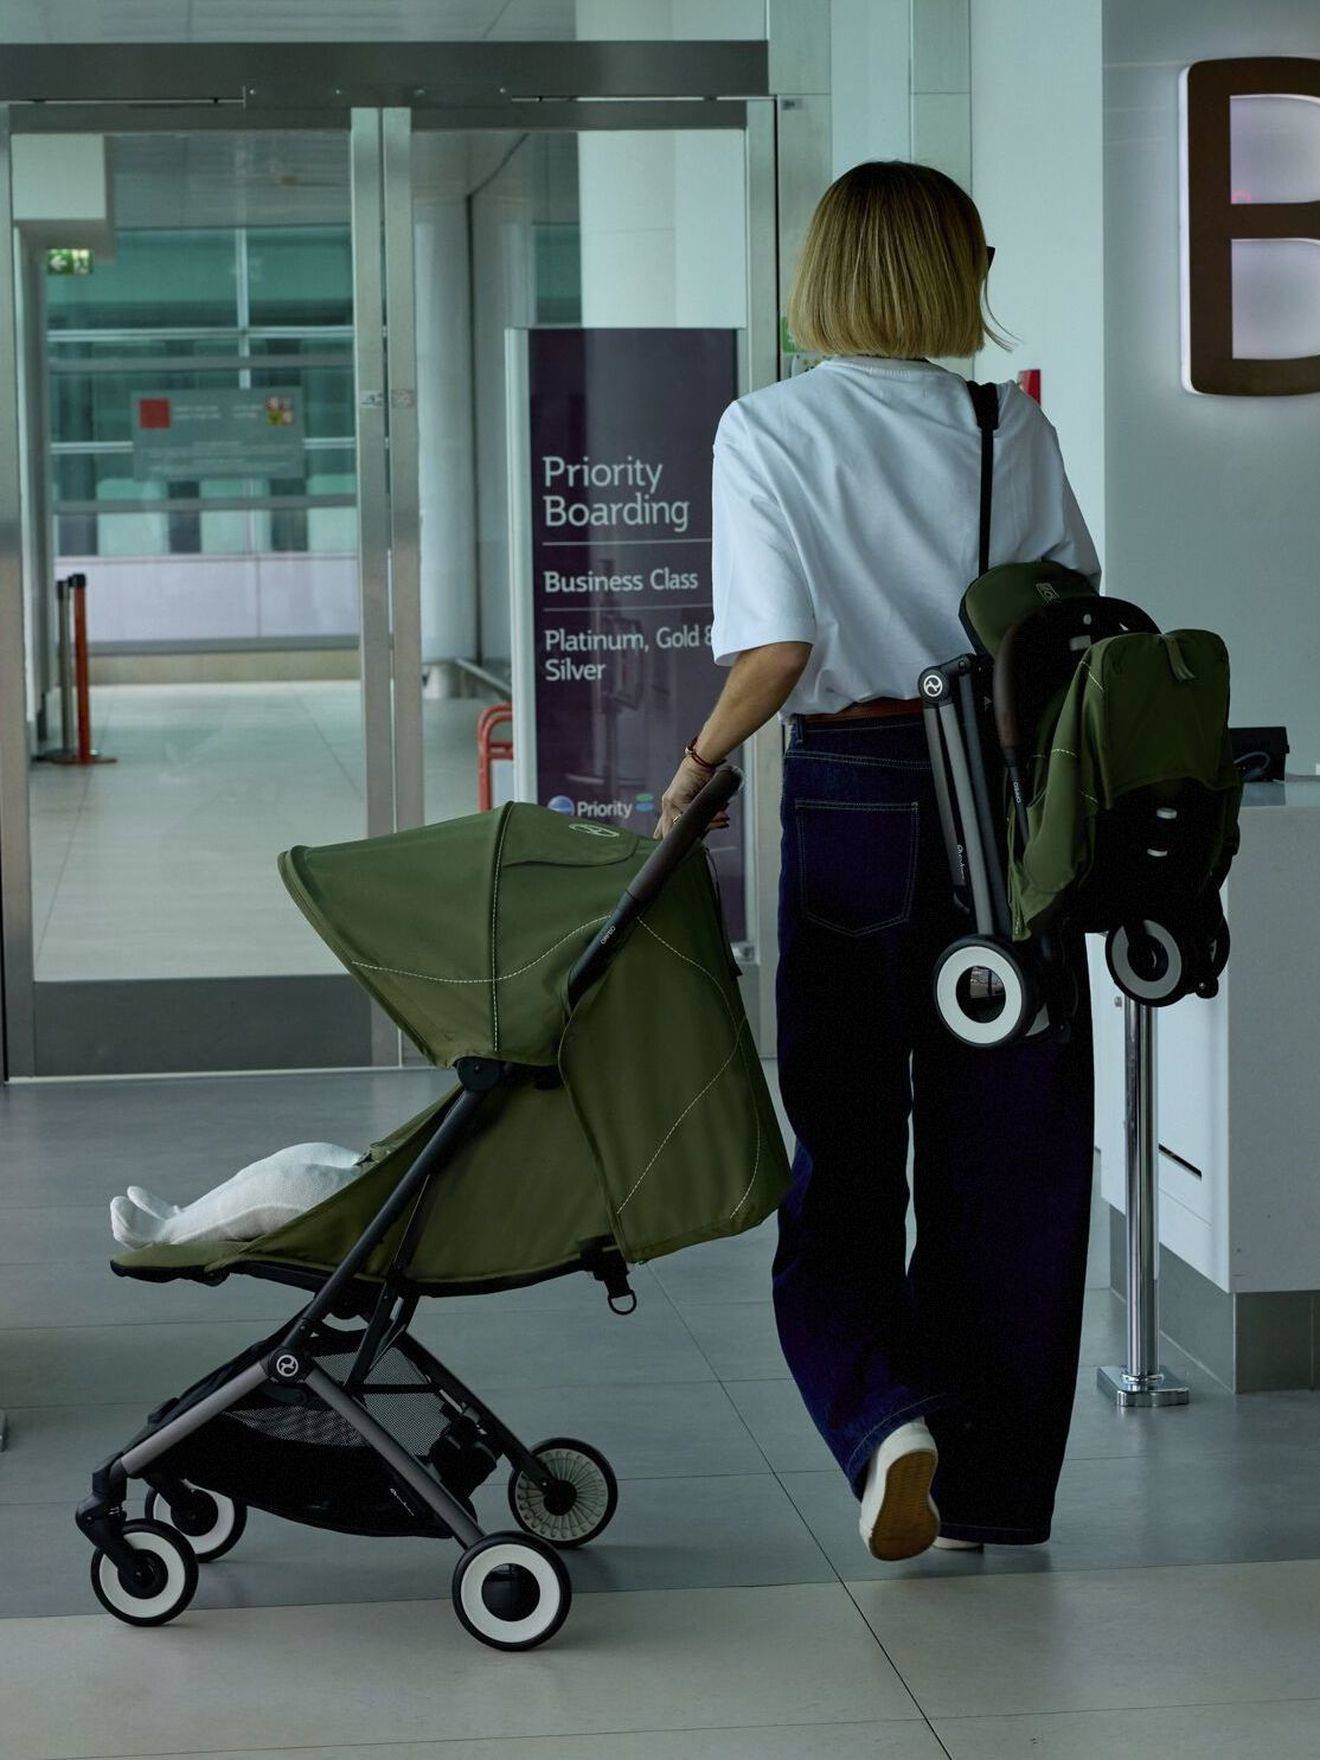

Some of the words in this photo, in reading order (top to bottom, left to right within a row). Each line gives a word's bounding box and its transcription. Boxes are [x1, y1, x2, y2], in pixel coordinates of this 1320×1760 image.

[542, 456, 663, 494] Priority
[543, 492, 690, 533] Boarding
[544, 570, 643, 593] Business
[649, 567, 698, 591] Class
[544, 628, 649, 653] Platinum,
[656, 624, 700, 649] Gold
[544, 658, 607, 682] Silver
[577, 800, 633, 819] Priority
